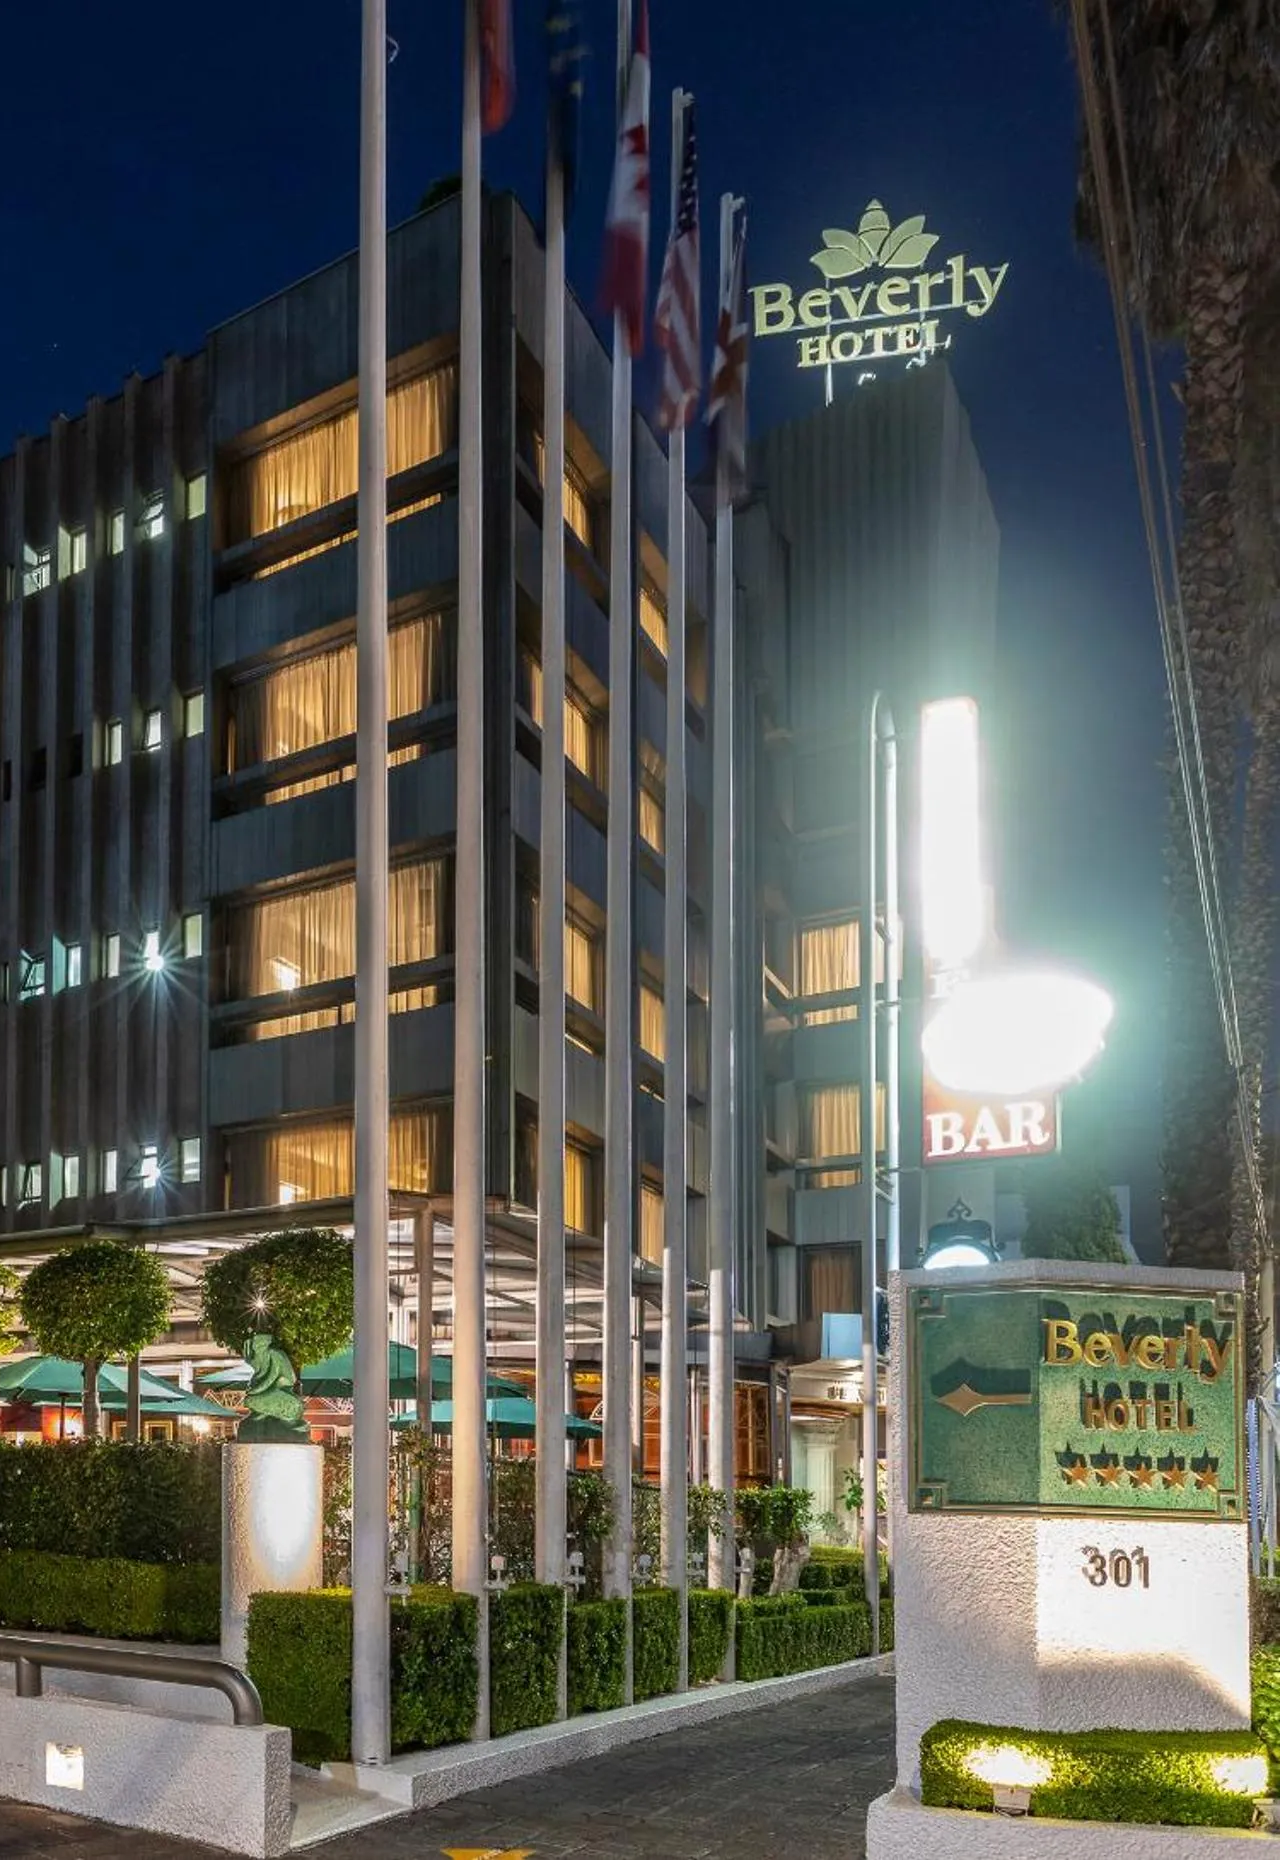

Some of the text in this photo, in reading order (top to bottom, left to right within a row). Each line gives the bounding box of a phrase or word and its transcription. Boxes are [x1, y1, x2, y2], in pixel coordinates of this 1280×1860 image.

[748, 255, 1009, 336] Beverly
[797, 319, 951, 367] HOTEL
[926, 1101, 1050, 1157] BAR
[1041, 1319, 1234, 1384] Beverly
[1082, 1390, 1198, 1433] HOTEL
[1083, 1548, 1151, 1589] 301
